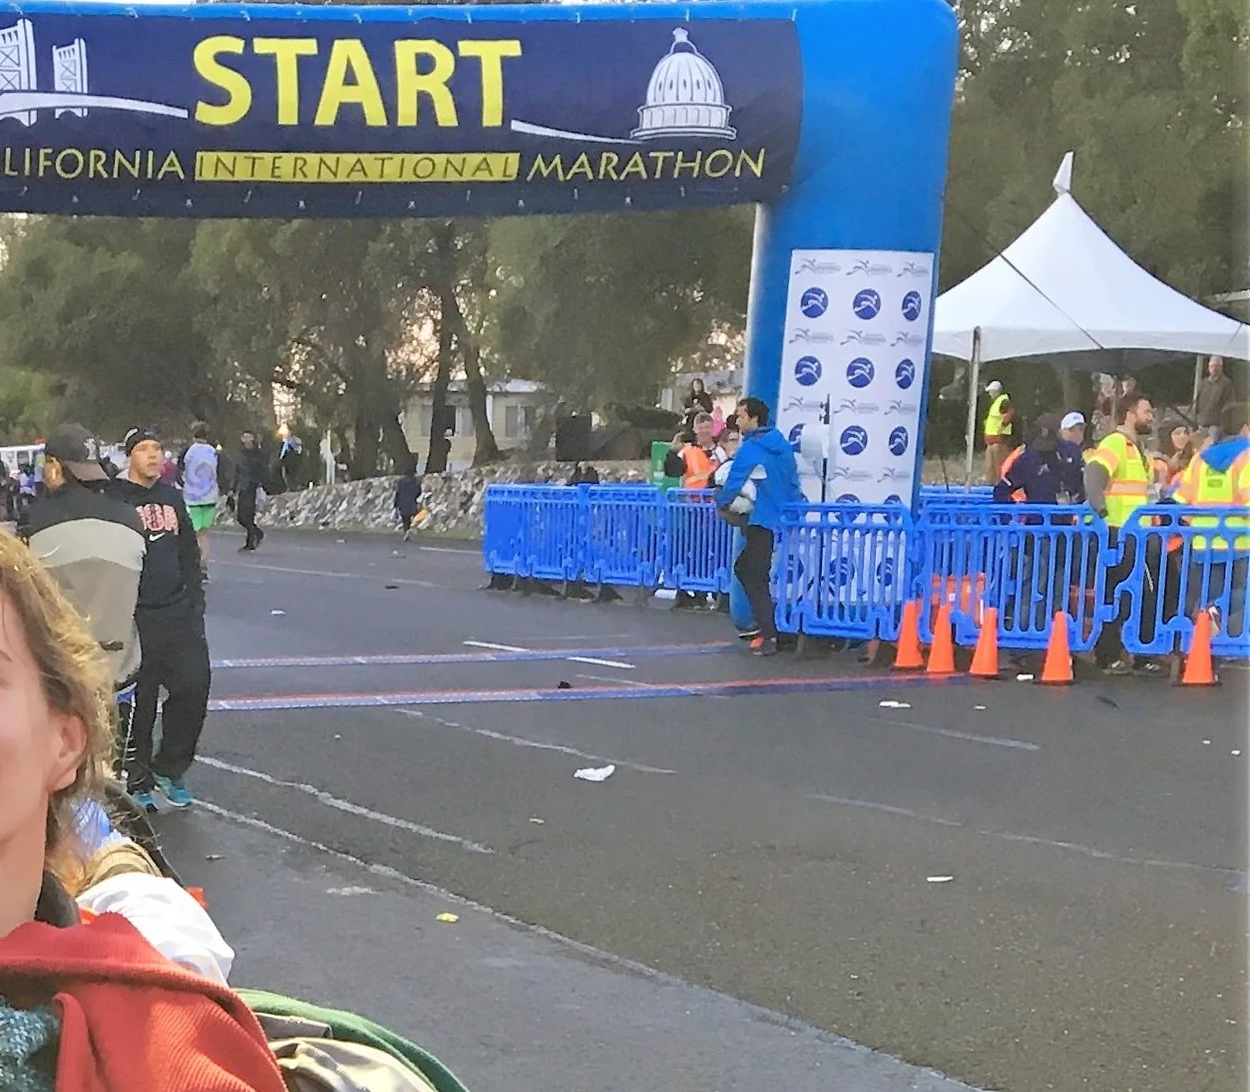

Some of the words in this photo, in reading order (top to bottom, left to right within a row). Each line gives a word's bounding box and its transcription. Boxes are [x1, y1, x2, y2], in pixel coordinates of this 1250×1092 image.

[193, 36, 522, 127] START
[198, 154, 514, 180] INTERNATIONAL
[526, 148, 766, 182] MARATHON
